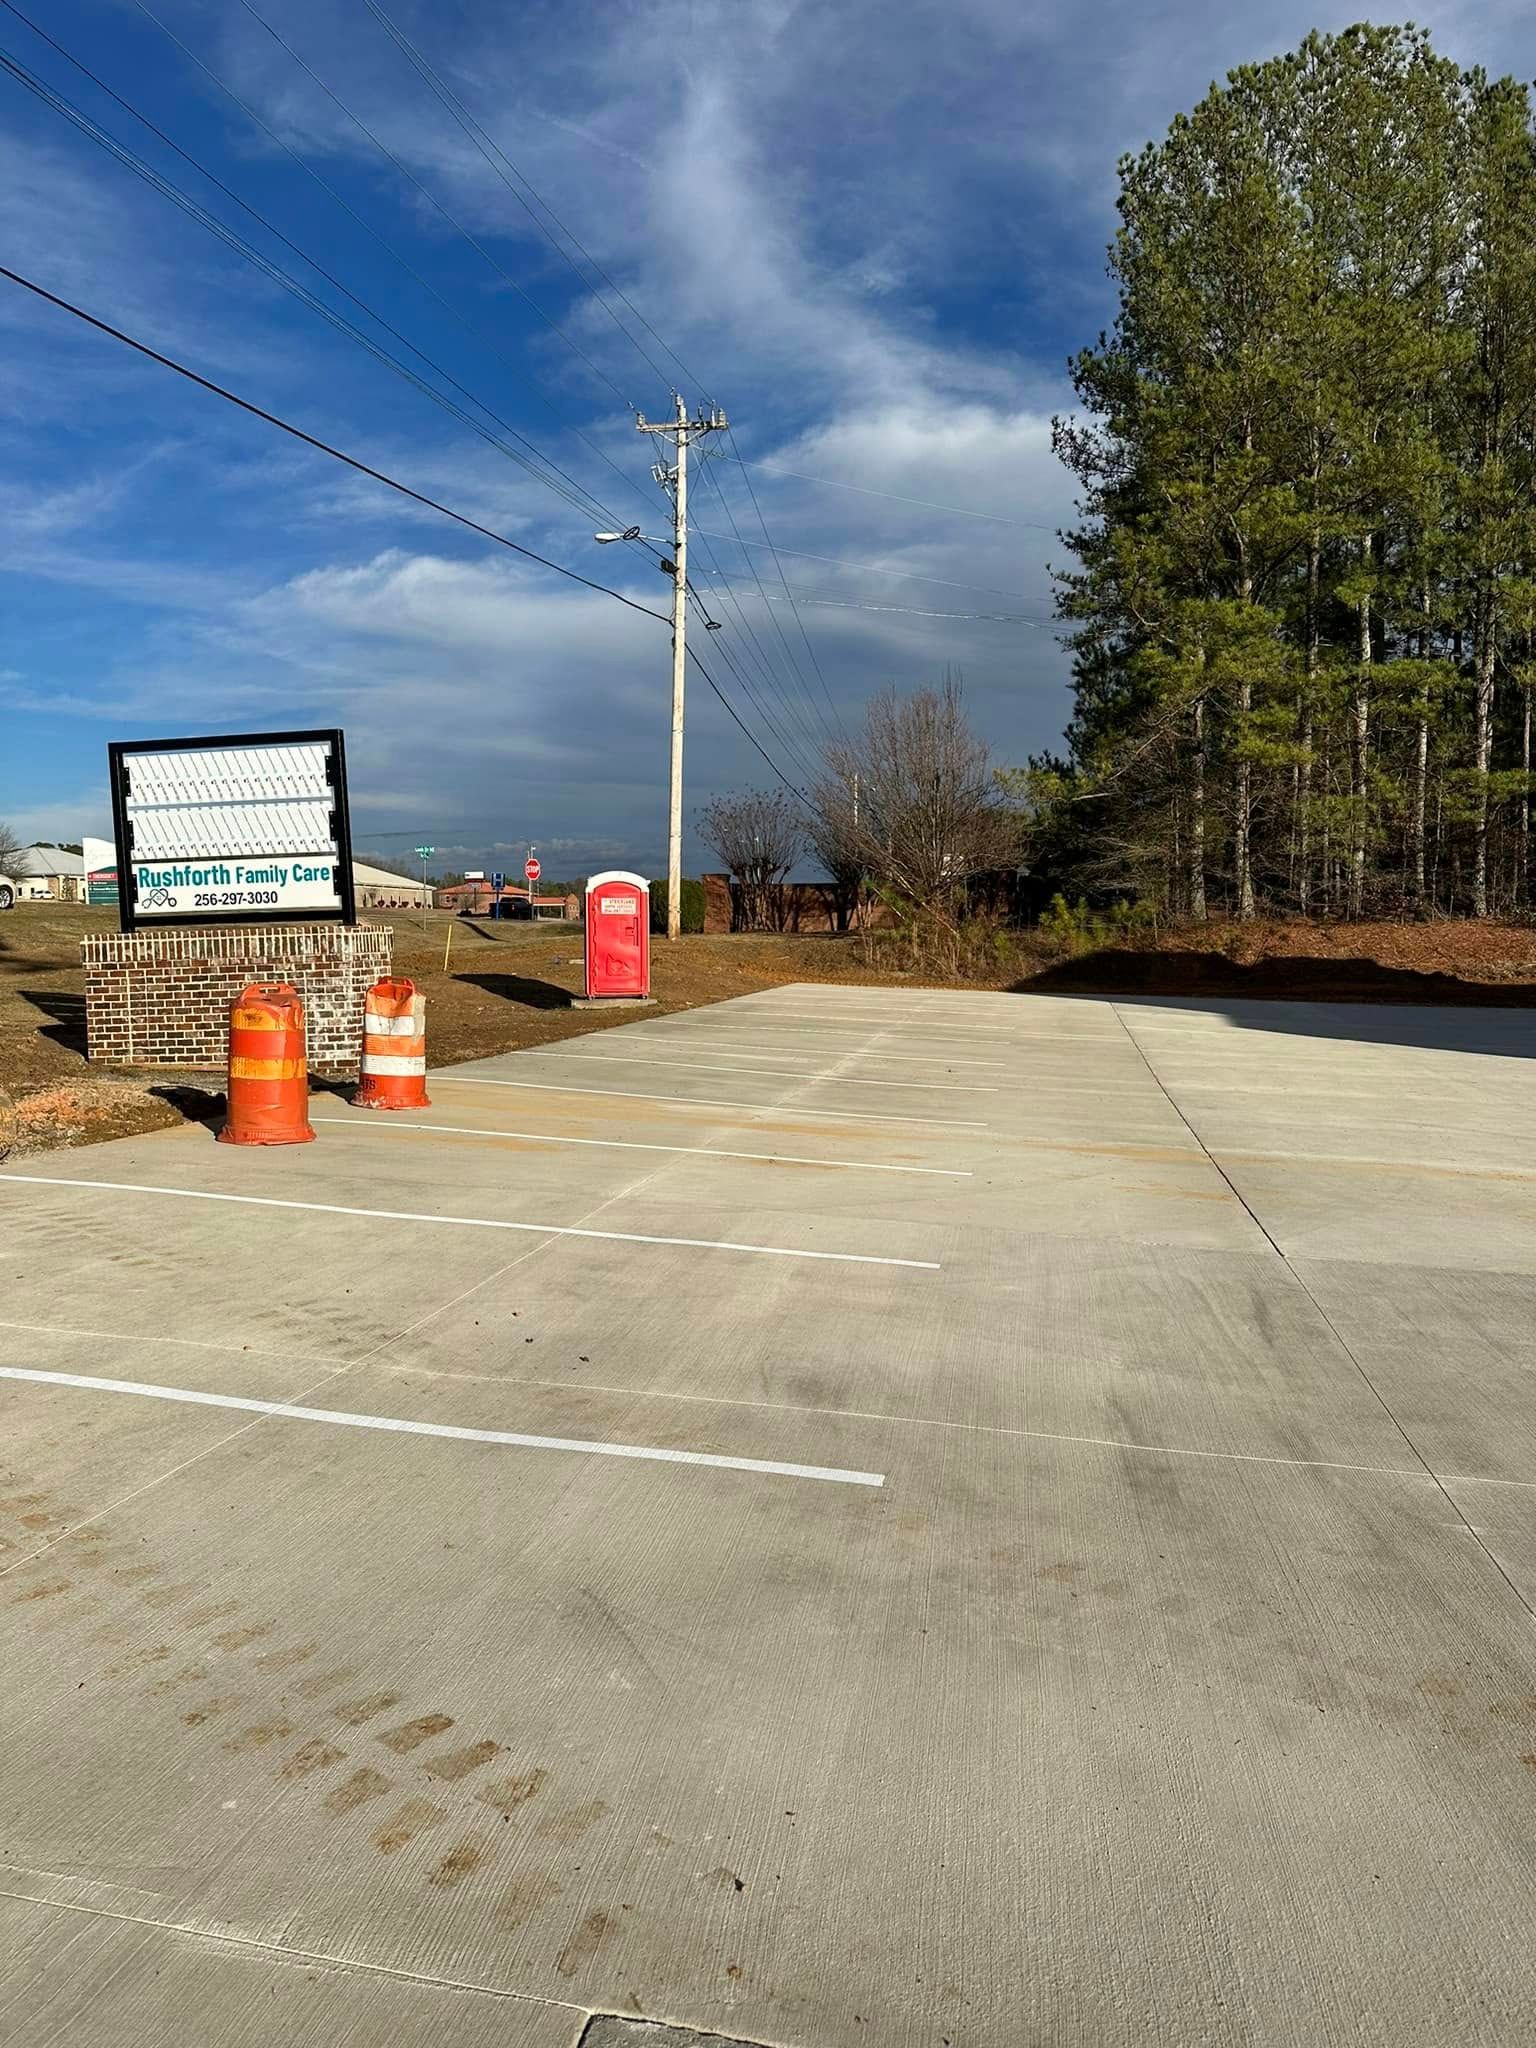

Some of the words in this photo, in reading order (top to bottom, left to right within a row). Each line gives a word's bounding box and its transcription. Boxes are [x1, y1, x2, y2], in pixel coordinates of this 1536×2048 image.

[138, 864, 231, 888] Rushforth
[236, 865, 288, 887] Family
[292, 864, 330, 882] Care
[526, 865, 540, 873] STOP
[194, 891, 278, 906] 256-297-3030
